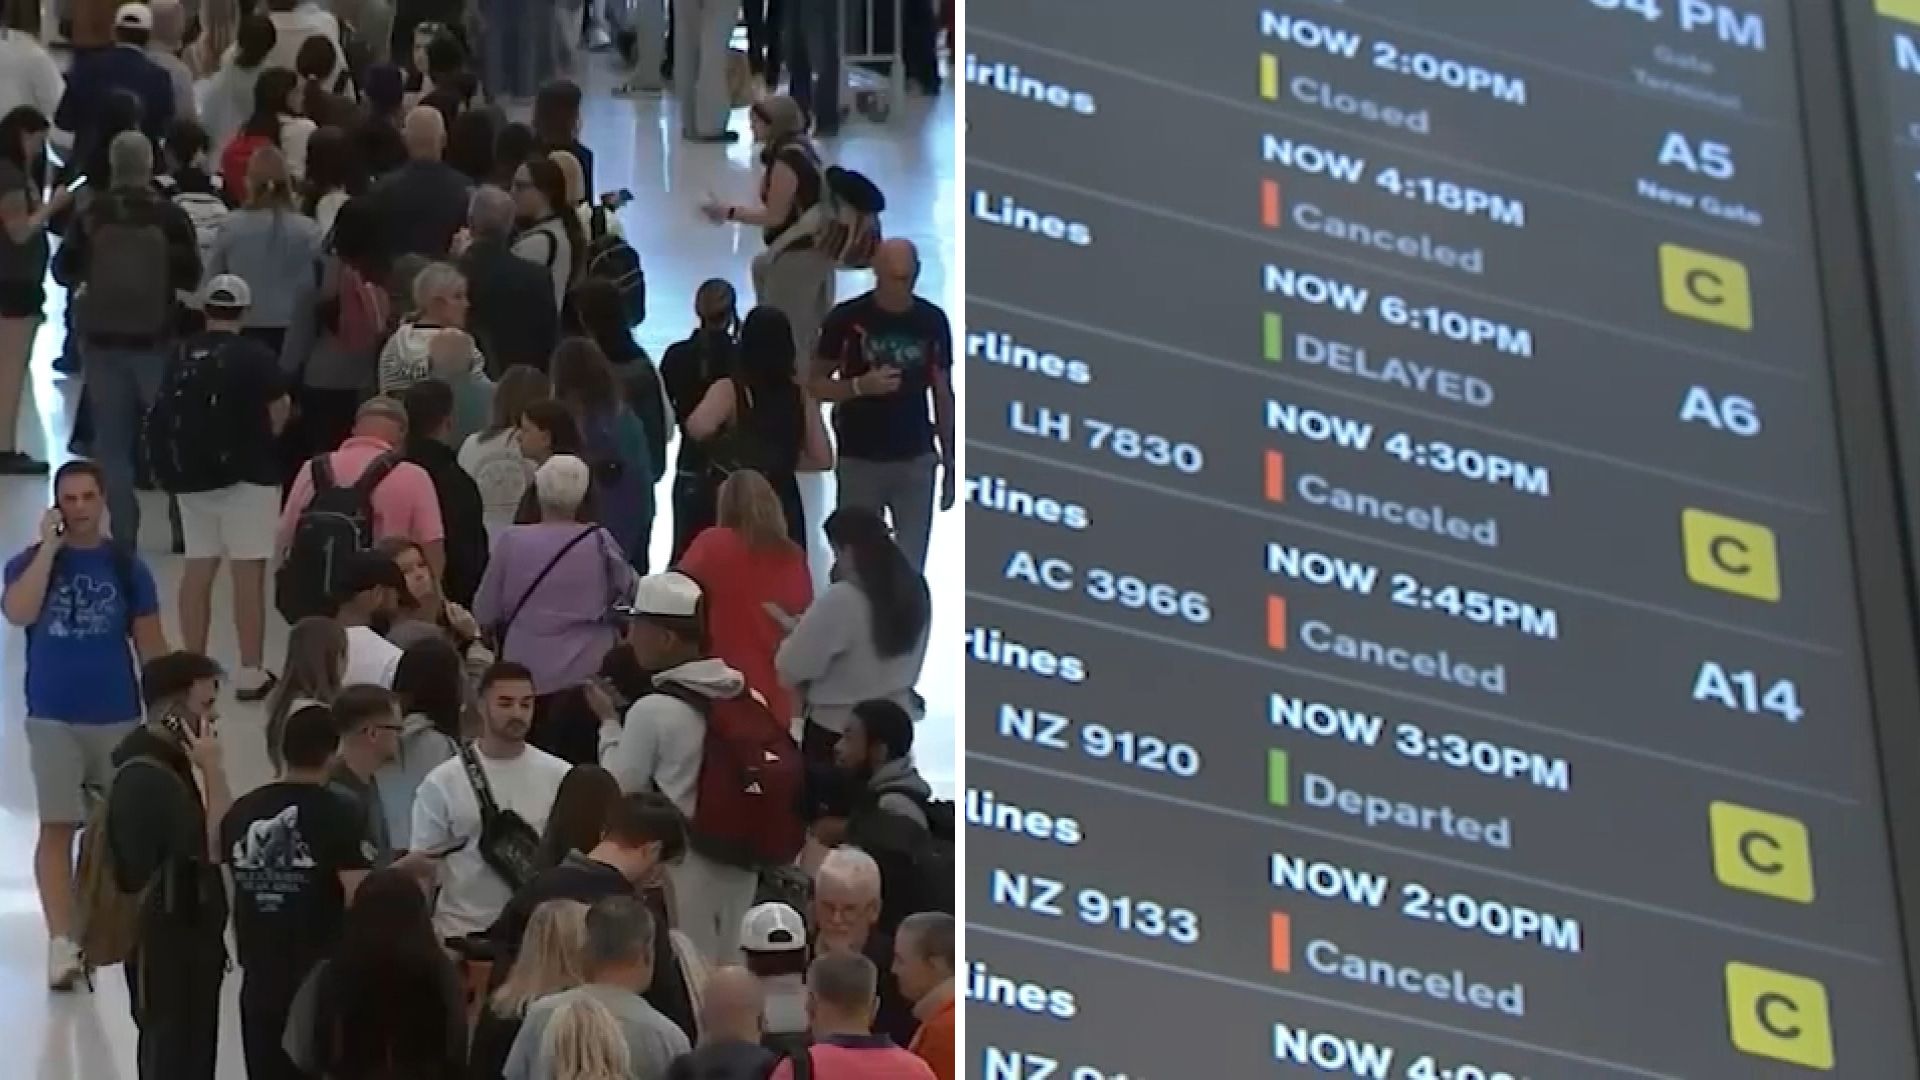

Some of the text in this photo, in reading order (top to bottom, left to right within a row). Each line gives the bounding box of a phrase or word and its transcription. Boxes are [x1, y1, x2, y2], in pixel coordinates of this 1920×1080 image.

[1261, 10, 1526, 105] NOW 2:00PM
[1679, 0, 1765, 50] PM
[1291, 75, 1430, 134] Closed
[1263, 134, 1525, 227] NOW 4:18PM
[1658, 131, 1735, 179] A5
[974, 190, 1092, 246] Lines
[1292, 203, 1483, 274] Canceled
[1637, 178, 1763, 226] New Gate
[1264, 264, 1533, 358] NOW 6:10PM
[1685, 268, 1725, 306] C
[1295, 333, 1494, 407] DELAYED
[1010, 400, 1204, 474] LH 7830
[1680, 385, 1761, 436] A6
[1266, 399, 1551, 497] NOW 4:30PM
[1297, 473, 1498, 547] Canceled
[1005, 551, 1211, 623] AC 3966
[1268, 542, 1559, 639] NOW 2:45PM
[1709, 535, 1752, 576] C
[1299, 620, 1506, 694] Canceled
[1692, 661, 1804, 723] A14
[999, 703, 1201, 777] NZ 9120
[1270, 692, 1569, 791] NOW 3:30PM
[1303, 772, 1512, 849] Departed
[1737, 830, 1785, 875] C
[993, 869, 1200, 944] NZ 9133
[1272, 853, 1581, 953] NOW 2:00PM
[1305, 939, 1525, 1017] Canceled
[1274, 1022, 1394, 1080] NOW
[1754, 991, 1802, 1040] C
[985, 1046, 1059, 1080] NZ
